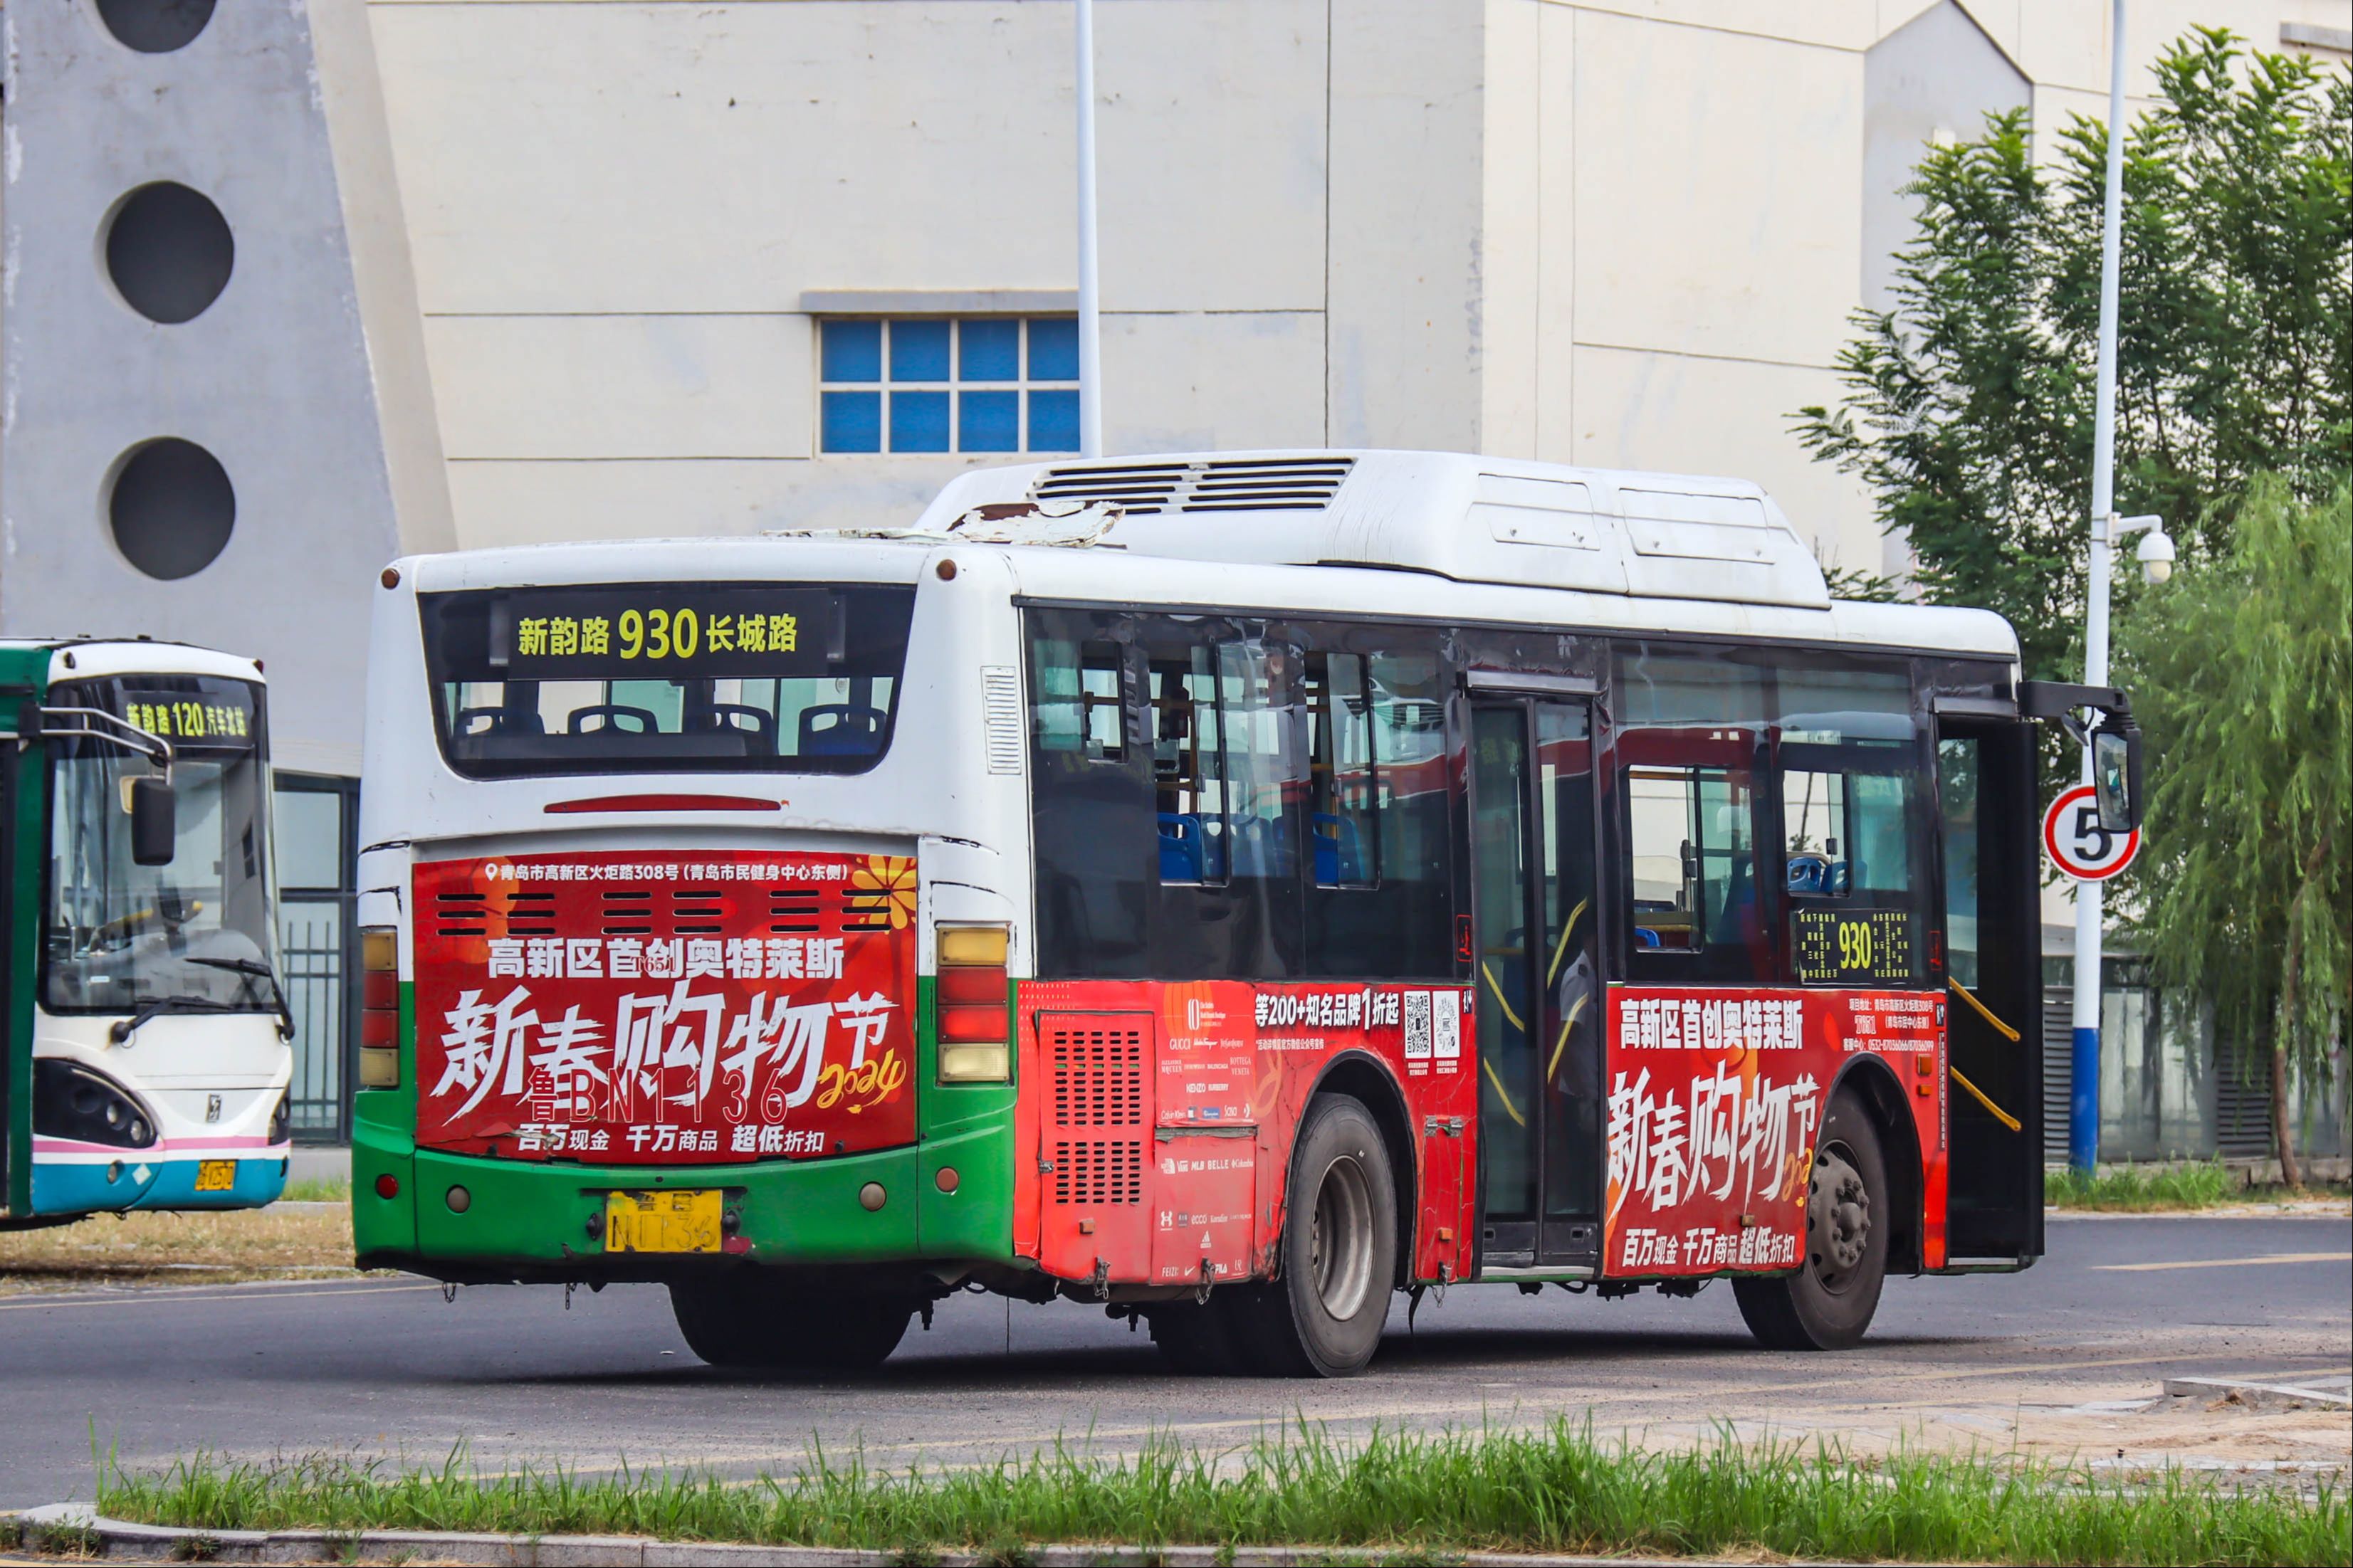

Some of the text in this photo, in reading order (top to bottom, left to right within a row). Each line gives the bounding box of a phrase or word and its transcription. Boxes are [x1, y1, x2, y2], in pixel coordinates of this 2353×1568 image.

[518, 609, 797, 659] 新韵路 930 长城路
[172, 702, 205, 737] 120
[2073, 806, 2113, 861] 5
[487, 937, 844, 979] 高新区首创奥特莱斯
[630, 955, 676, 974] T651
[1839, 922, 1872, 969] 930
[1254, 988, 1399, 1031] 等200+知名品牌1折起
[1620, 998, 1803, 1050] 高新区首创奥特莱斯
[430, 979, 901, 1127] 新春购物节
[1170, 1038, 1191, 1050] GUCCI
[1230, 1056, 1252, 1065] BOTTEGA
[528, 1068, 789, 1124] 鲁BN1136
[817, 1047, 907, 1112] 2024
[518, 1124, 824, 1153] 百万现金 千万商品 超低折扣
[1607, 1059, 1821, 1226] 新春购物节
[1191, 1160, 1205, 1171] MLB
[1207, 1159, 1230, 1171] BELLE
[1622, 1226, 1796, 1267] 百万现金 千万商品 超低折扣
